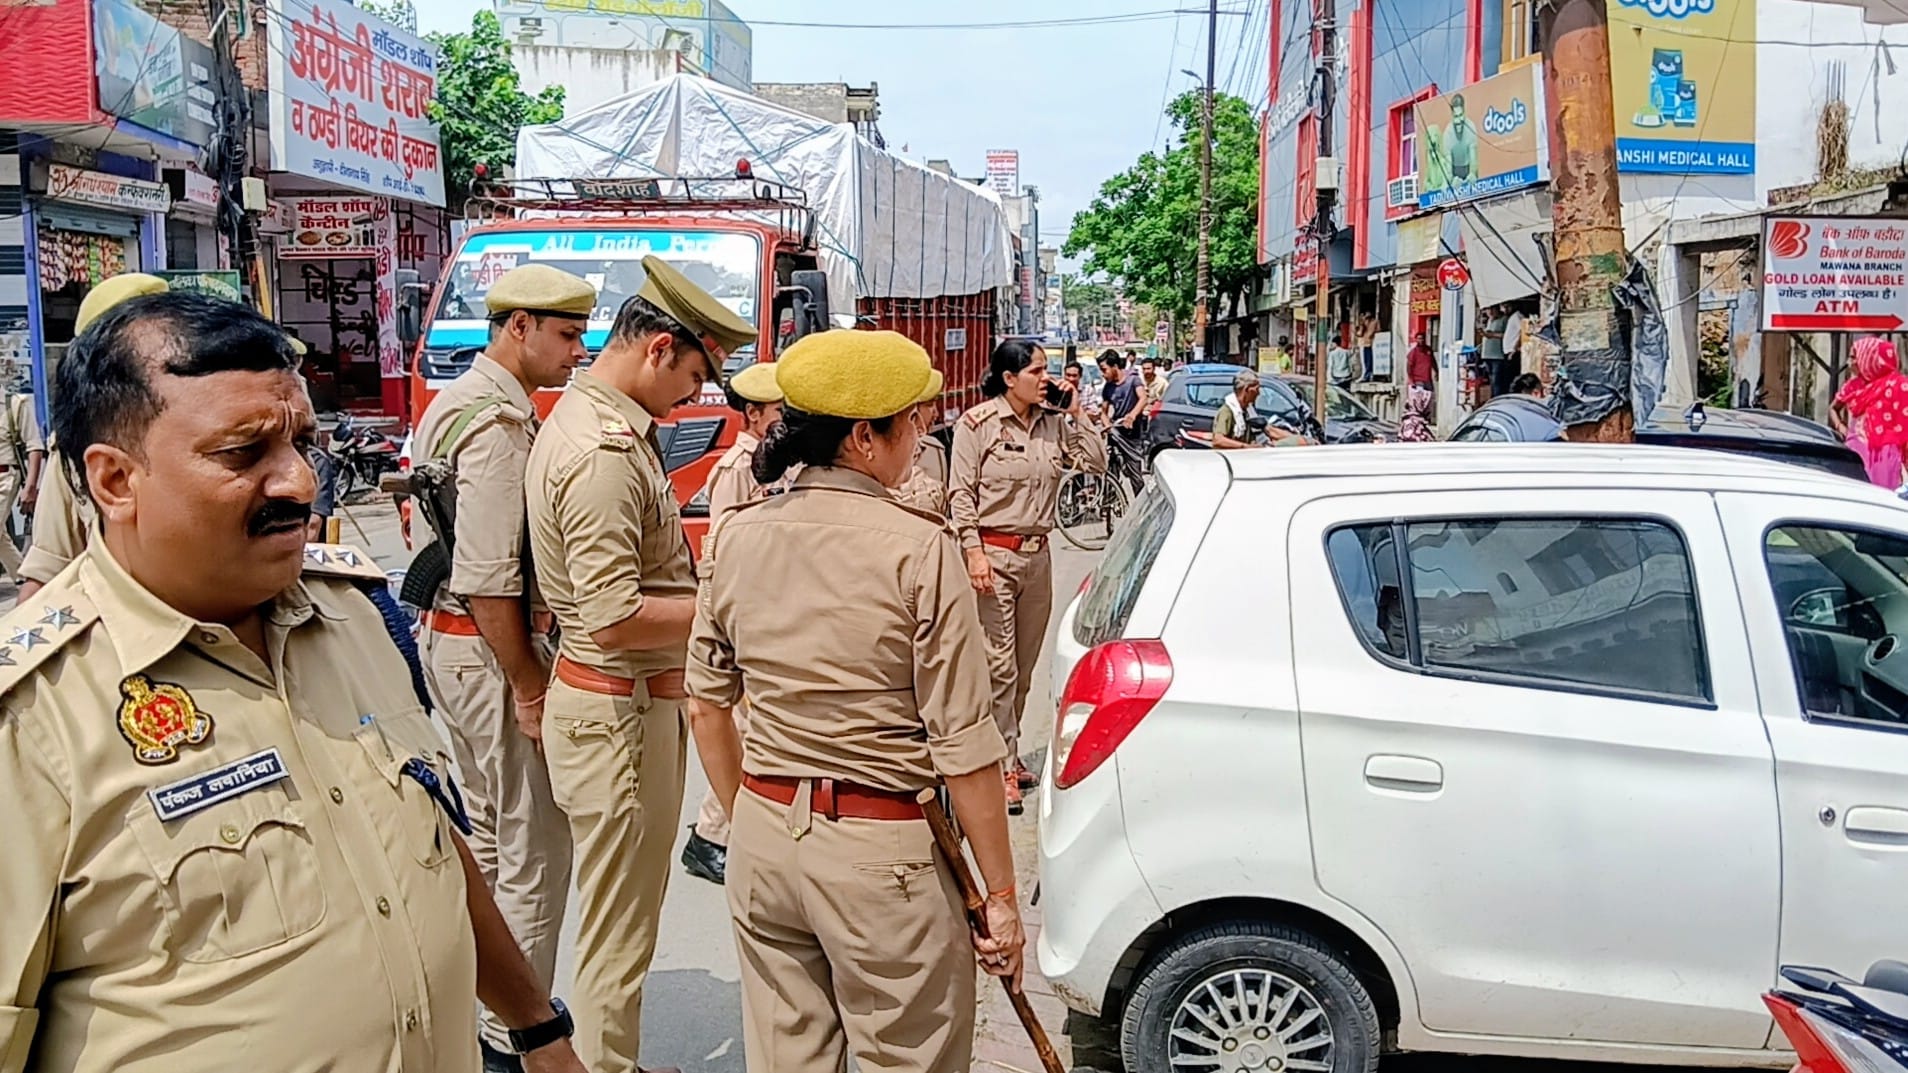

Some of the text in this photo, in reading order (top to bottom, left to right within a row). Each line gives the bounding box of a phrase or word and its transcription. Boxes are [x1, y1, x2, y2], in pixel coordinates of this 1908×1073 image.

[289, 4, 374, 103] अंग्रेजी
[372, 29, 433, 72] मॉडल शॉप
[1484, 98, 1526, 133] drools
[292, 98, 304, 136] व
[307, 97, 341, 150] ठण्डी
[381, 117, 399, 164] की
[401, 135, 438, 180] दुकान
[1658, 151, 1713, 166] MEDICAL
[1717, 152, 1750, 167] HALL
[1472, 177, 1503, 195] MEDICAL
[1504, 172, 1525, 186] HALL
[297, 199, 372, 213] मॉडल शॉप
[542, 234, 576, 250] All
[593, 233, 652, 251] India
[1820, 245, 1905, 260] Bank of Baroda
[1820, 261, 1902, 271] MAWANA BRANCH
[1764, 273, 1904, 286] GOLD LOAN AVAILABLE
[1778, 286, 1807, 299] गोल्ड
[1811, 286, 1835, 299] लोन
[1814, 300, 1859, 313] ATM
[160, 784, 204, 809] पंकज
